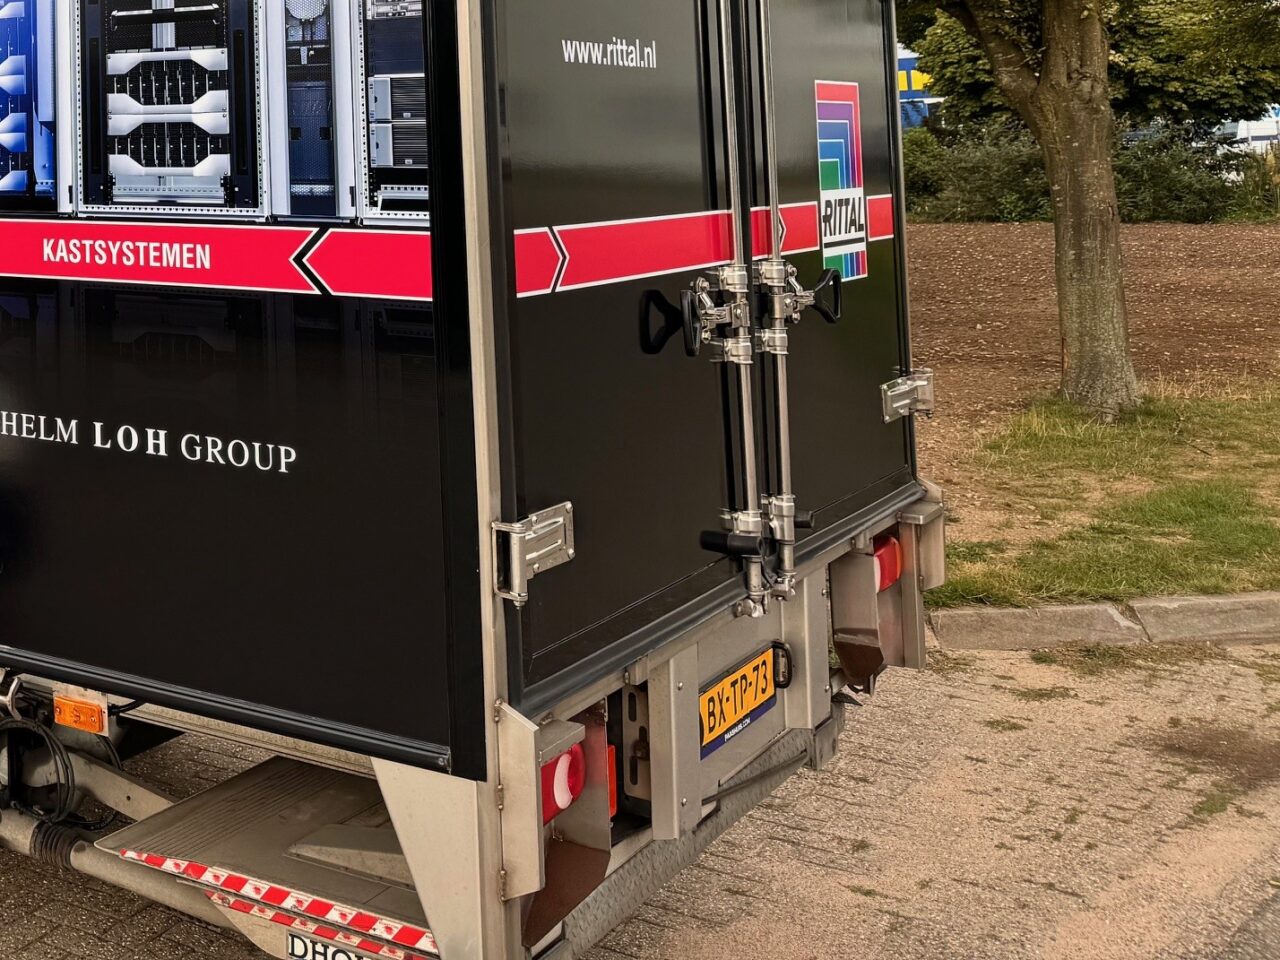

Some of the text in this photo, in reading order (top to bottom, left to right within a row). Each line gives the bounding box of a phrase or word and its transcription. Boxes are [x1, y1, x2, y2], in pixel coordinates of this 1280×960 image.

[561, 36, 657, 68] www.rittal.nl
[822, 196, 864, 237] RITTAL
[42, 239, 212, 270] KASTSYSTEMEN
[92, 421, 169, 457] LOH
[180, 433, 298, 474] GROUP
[707, 659, 768, 734] BX-TP-73
